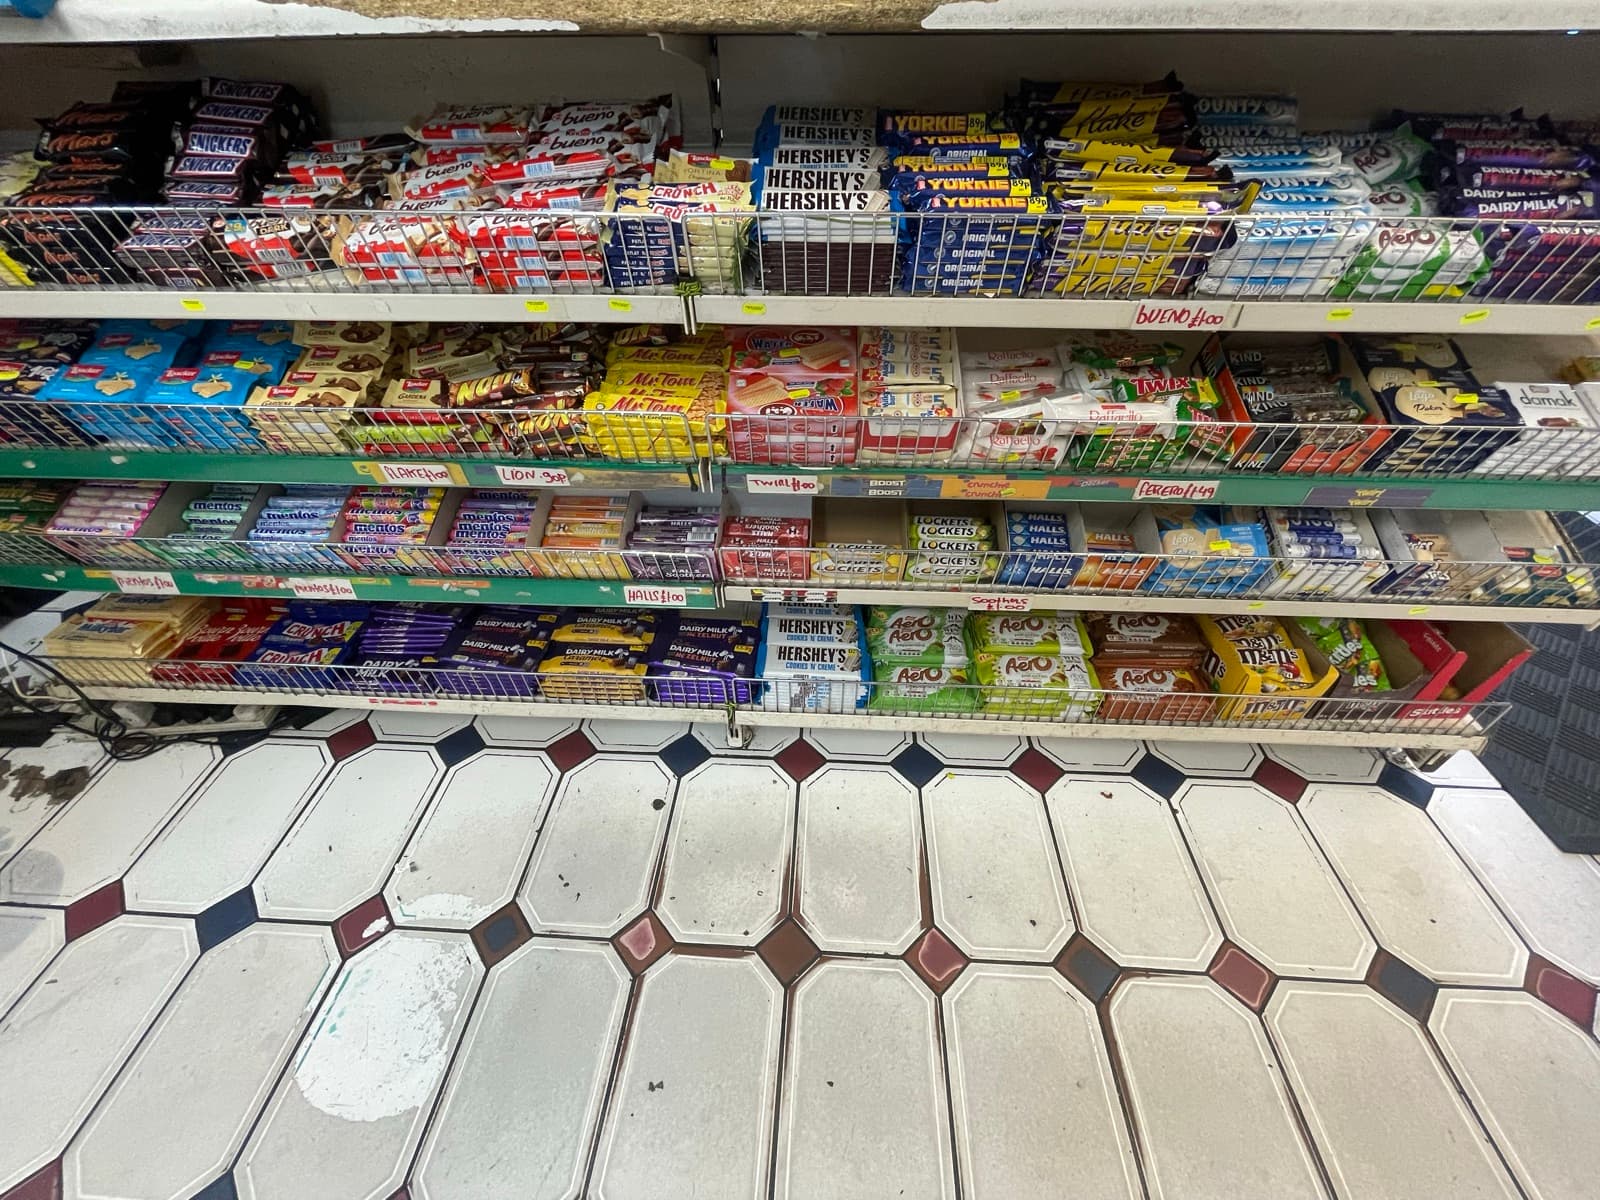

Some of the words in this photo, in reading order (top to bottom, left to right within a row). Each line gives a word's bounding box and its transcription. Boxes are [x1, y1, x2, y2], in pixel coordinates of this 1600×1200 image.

[214, 82, 277, 99] SNICKERS
[205, 104, 267, 122] SNICKERS
[562, 110, 615, 126] bueno
[779, 106, 864, 122] HERSHEY'S
[895, 116, 967, 132] YORKIE
[969, 118, 985, 129] 89p
[784, 126, 873, 141] HERSHEY'S
[189, 134, 251, 155] SNICKERS
[550, 136, 605, 151] bueno
[778, 149, 870, 163] HERSHEY'S
[182, 157, 238, 174] SNICKERS
[425, 161, 473, 179] bueno
[768, 169, 865, 190] HERSHEY'S
[653, 182, 718, 199] CRUNCH
[1463, 188, 1504, 199] DAIRY
[766, 192, 868, 210] HERSHEY'S
[1478, 201, 1521, 213] DAIRY
[1523, 199, 1558, 212] MILK
[259, 223, 287, 235] DARK
[1230, 352, 1262, 363] KIND
[659, 373, 697, 385] Tom
[1131, 377, 1191, 395] TWIX
[1519, 389, 1578, 408] damak
[1251, 400, 1288, 415] KIND
[479, 492, 528, 500] mentos
[192, 502, 242, 511] mentos
[462, 513, 514, 522] mentos
[917, 517, 968, 526] LOCKETS
[1028, 514, 1064, 522] HALLS
[354, 523, 405, 533] mentos
[458, 523, 510, 532] mentos
[921, 526, 974, 536] LOCKETS
[1029, 525, 1066, 534] HALLS
[455, 530, 508, 539] mentos
[1031, 536, 1068, 545] HALLS
[1095, 533, 1130, 542] HALLS
[921, 541, 976, 551] LOCKETS
[628, 590, 659, 602] HALLS
[475, 619, 501, 627] DAIRY
[602, 617, 623, 625] MILK
[779, 619, 844, 635] HERSHEY'S
[287, 622, 345, 637] CRUNCH
[462, 640, 489, 648] DAIRY
[488, 643, 511, 652] MILK
[670, 645, 698, 653] DAIRY
[697, 648, 720, 658] MILK
[778, 646, 847, 663] HERSHEY'S
[1236, 649, 1299, 666] m&m's
[817, 663, 836, 671] CREME
